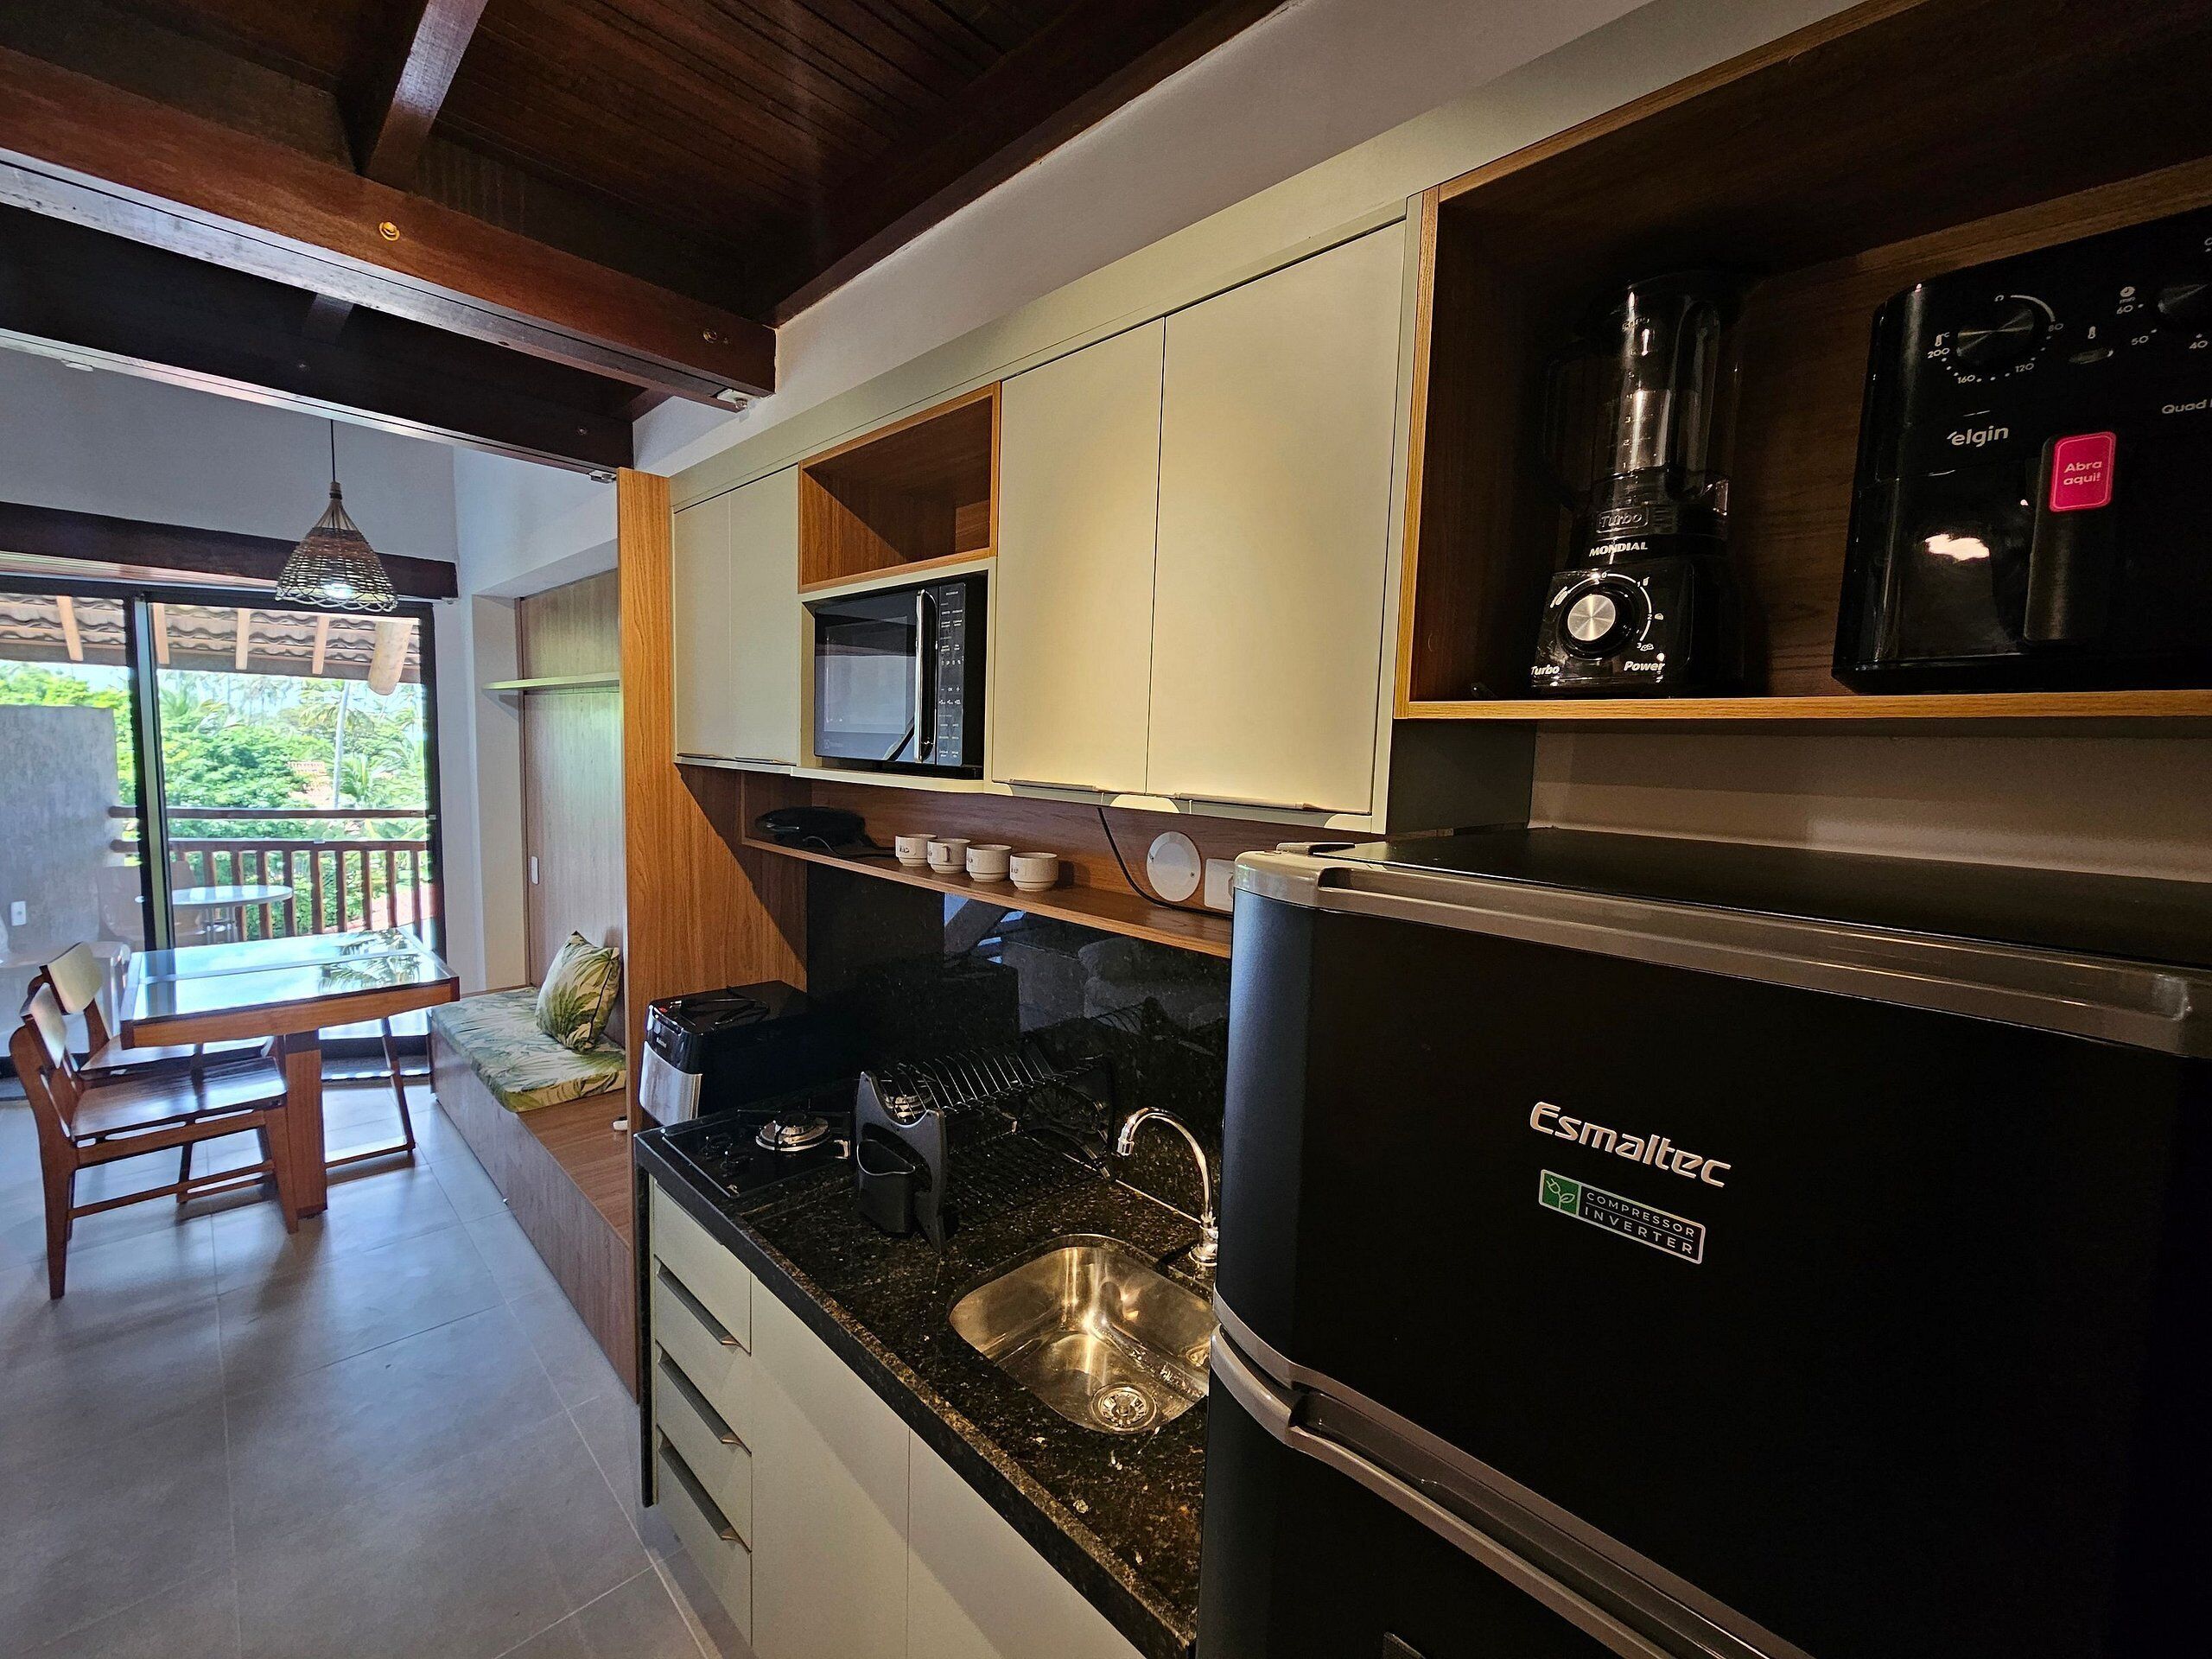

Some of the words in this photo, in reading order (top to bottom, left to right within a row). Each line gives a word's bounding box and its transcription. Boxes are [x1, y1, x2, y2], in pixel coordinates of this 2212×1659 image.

[2116, 304, 2133, 315] 60
[2048, 322, 2064, 333] 80
[2131, 335, 2149, 346] 50
[2189, 340, 2209, 350] 40
[1927, 347, 1950, 359] 200
[2015, 362, 2035, 373] 120
[1957, 374, 1976, 384] 160
[2161, 398, 2208, 415] Quad
[1948, 424, 2009, 447] elgin
[2064, 461, 2102, 474] Abra
[2063, 471, 2101, 486] aqui!
[1601, 512, 1643, 528] Turbo
[1588, 542, 1649, 557] MONDIAL
[1530, 664, 1560, 676] Turbo
[1624, 661, 1665, 672] Power
[1529, 1101, 1732, 1188] Esmaltec
[1586, 1192, 1694, 1237] COMPRESSOR
[1585, 1206, 1693, 1255] INVERTER
